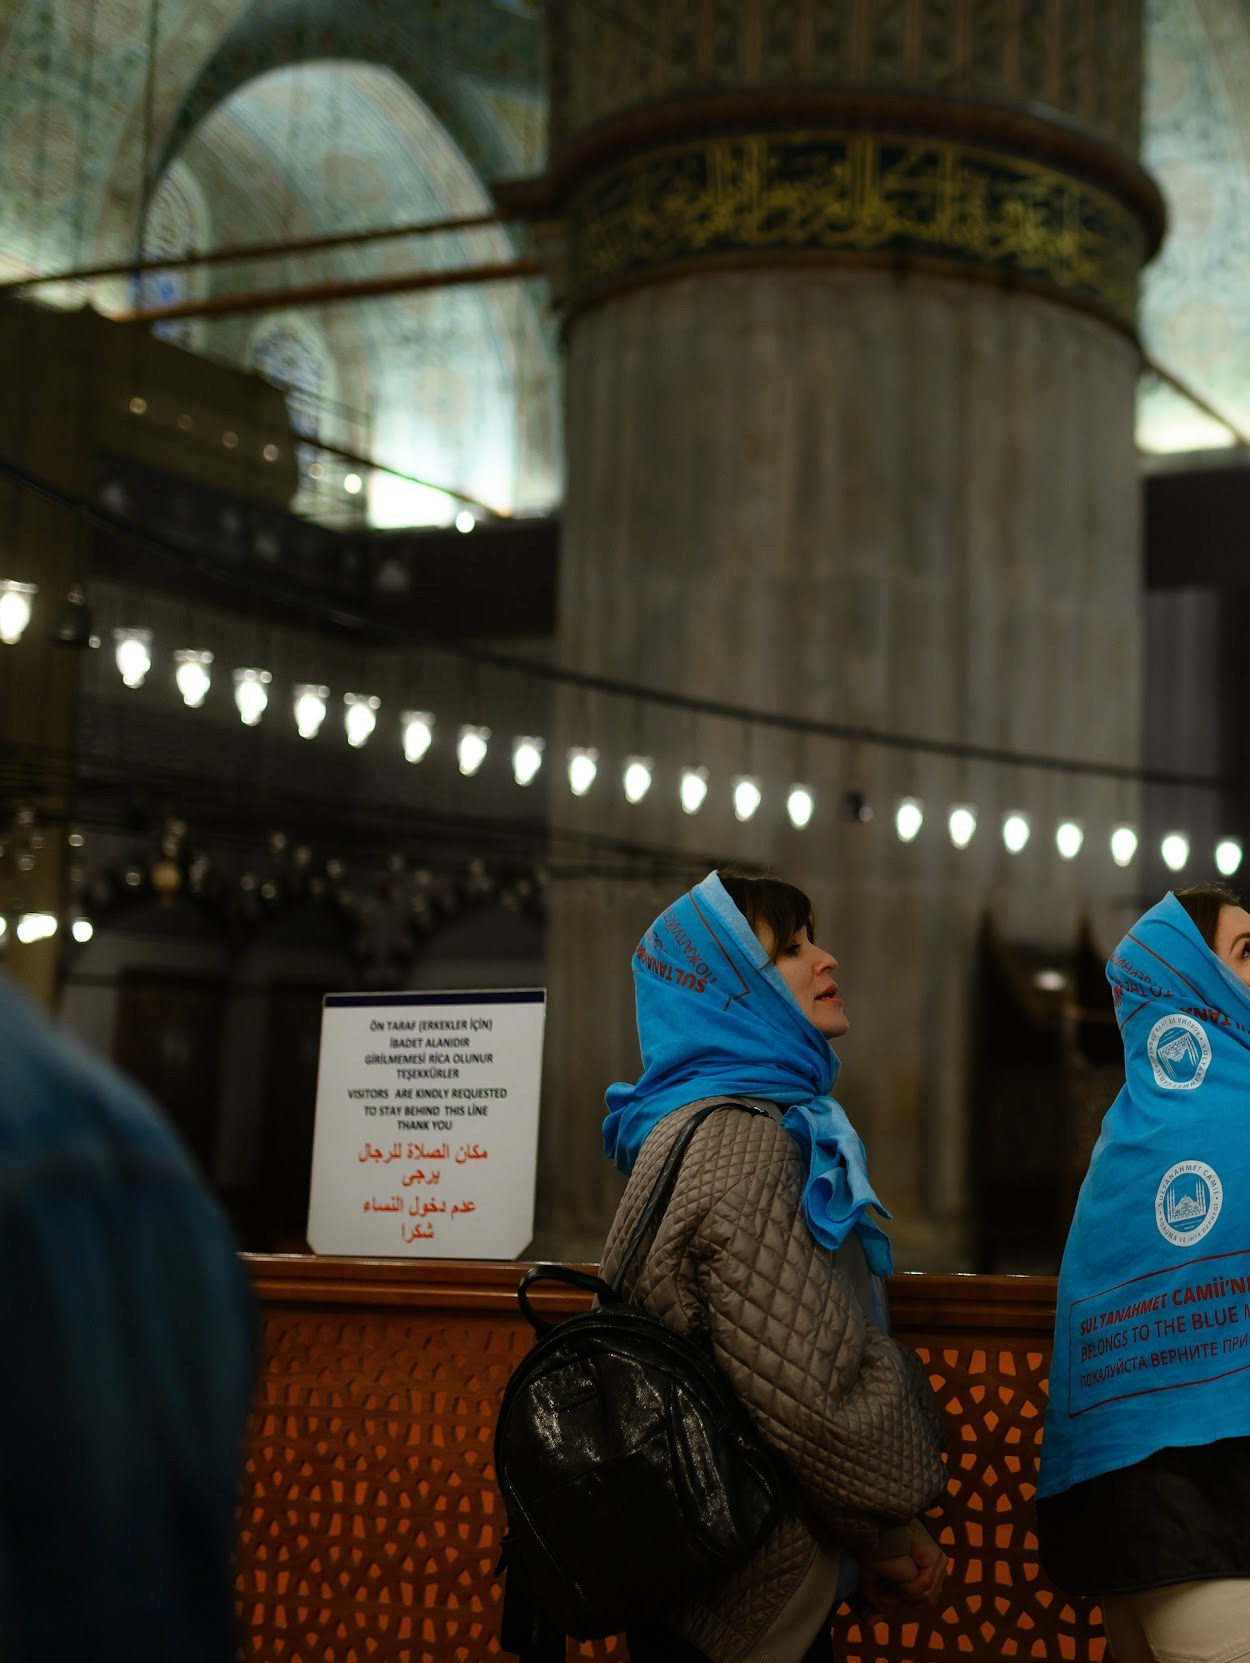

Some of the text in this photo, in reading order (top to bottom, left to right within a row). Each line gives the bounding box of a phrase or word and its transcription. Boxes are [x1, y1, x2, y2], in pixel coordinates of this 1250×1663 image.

[370, 1017, 492, 1033] ÖN TARAF (ERKEKLER İÇİN)
[1177, 1018, 1200, 1038] KORUMA
[390, 1037, 470, 1049] İBADET ALANIDIR
[364, 1052, 493, 1065] GİRİLMEMESİ RİCA OLUNUR
[396, 1068, 459, 1081] TEŞEKKÜRLER
[348, 1088, 507, 1100] VISITORS ARE KINDLY REQUESTED
[364, 1105, 377, 1116] TO
[379, 1105, 401, 1116] STAY
[404, 1105, 440, 1116] BEHIND
[445, 1106, 465, 1116] THIS
[397, 1120, 452, 1131] THANK YOU
[358, 1142, 488, 1165] مكان الصلاة للرجال
[1158, 1165, 1202, 1208] SULTANAHMET
[363, 1195, 476, 1222] عدم دخول النساء
[401, 1222, 435, 1244] شكرا
[1159, 1217, 1177, 1242] KORUMA
[1080, 1293, 1168, 1337] SULTANAHMET
[1081, 1330, 1128, 1363] BELONGS
[1132, 1324, 1150, 1343] TO
[1154, 1316, 1187, 1338] THE
[1192, 1306, 1239, 1331] BLUE
[1080, 1355, 1148, 1389] ПОЖАЛУЙСТА
[1150, 1340, 1218, 1368] ВЕРНИТЕ
[1222, 1333, 1250, 1355] ПРИ
